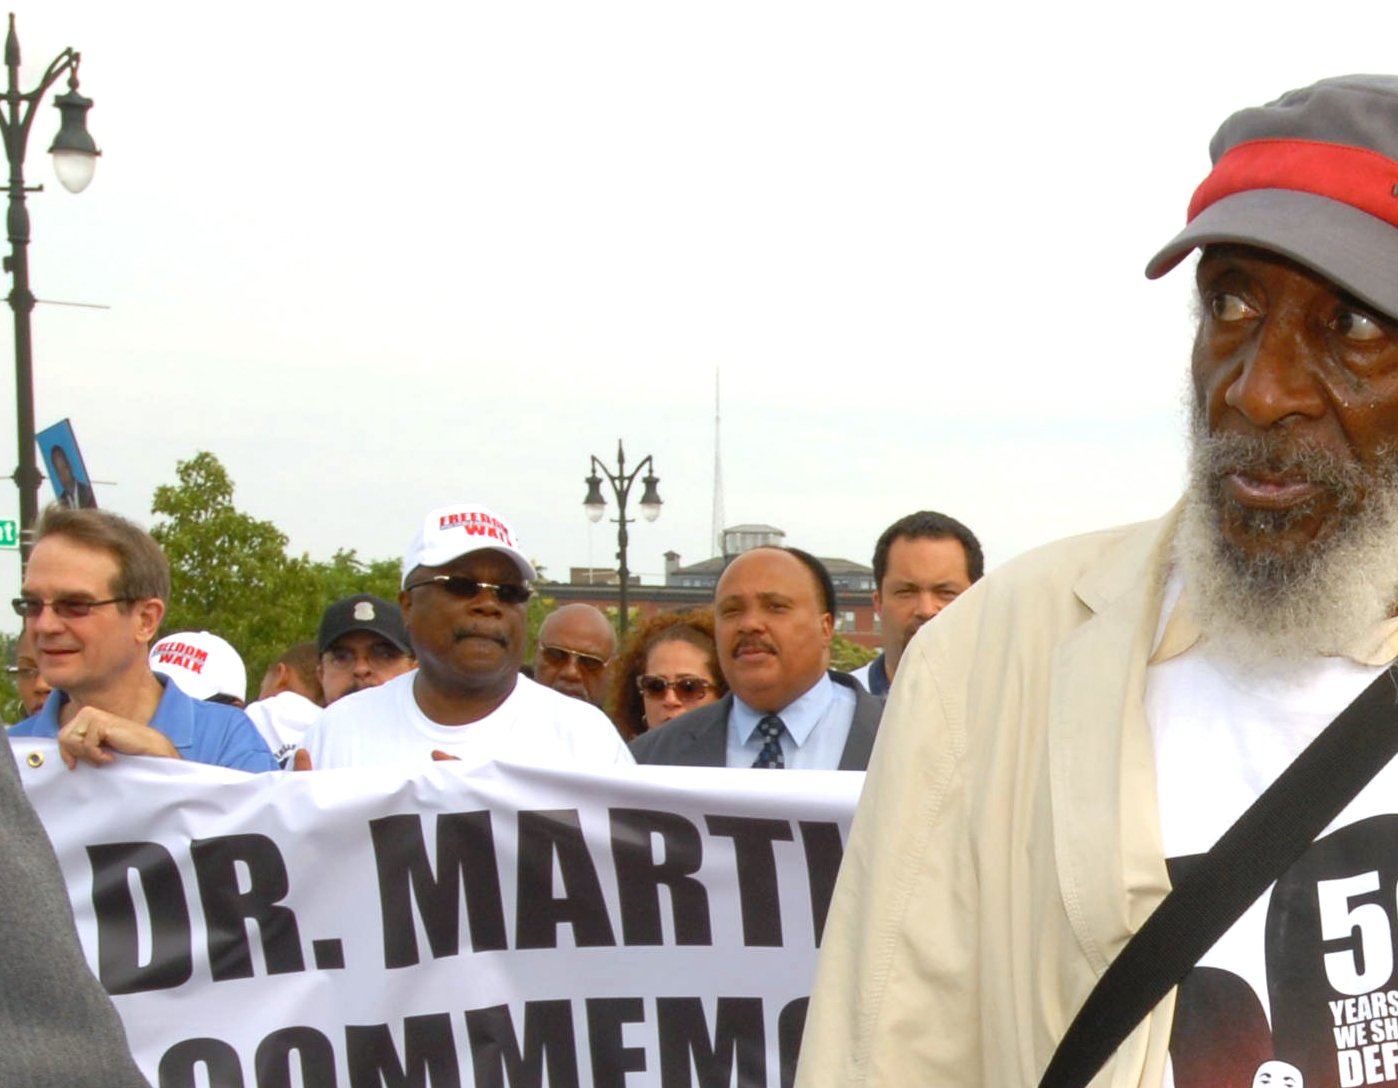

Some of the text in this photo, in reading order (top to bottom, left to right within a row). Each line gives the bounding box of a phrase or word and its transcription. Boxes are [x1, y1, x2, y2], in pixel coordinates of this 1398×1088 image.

[158, 654, 203, 675] WALK
[85, 832, 346, 997] DR.
[1332, 1026, 1368, 1051] WE
